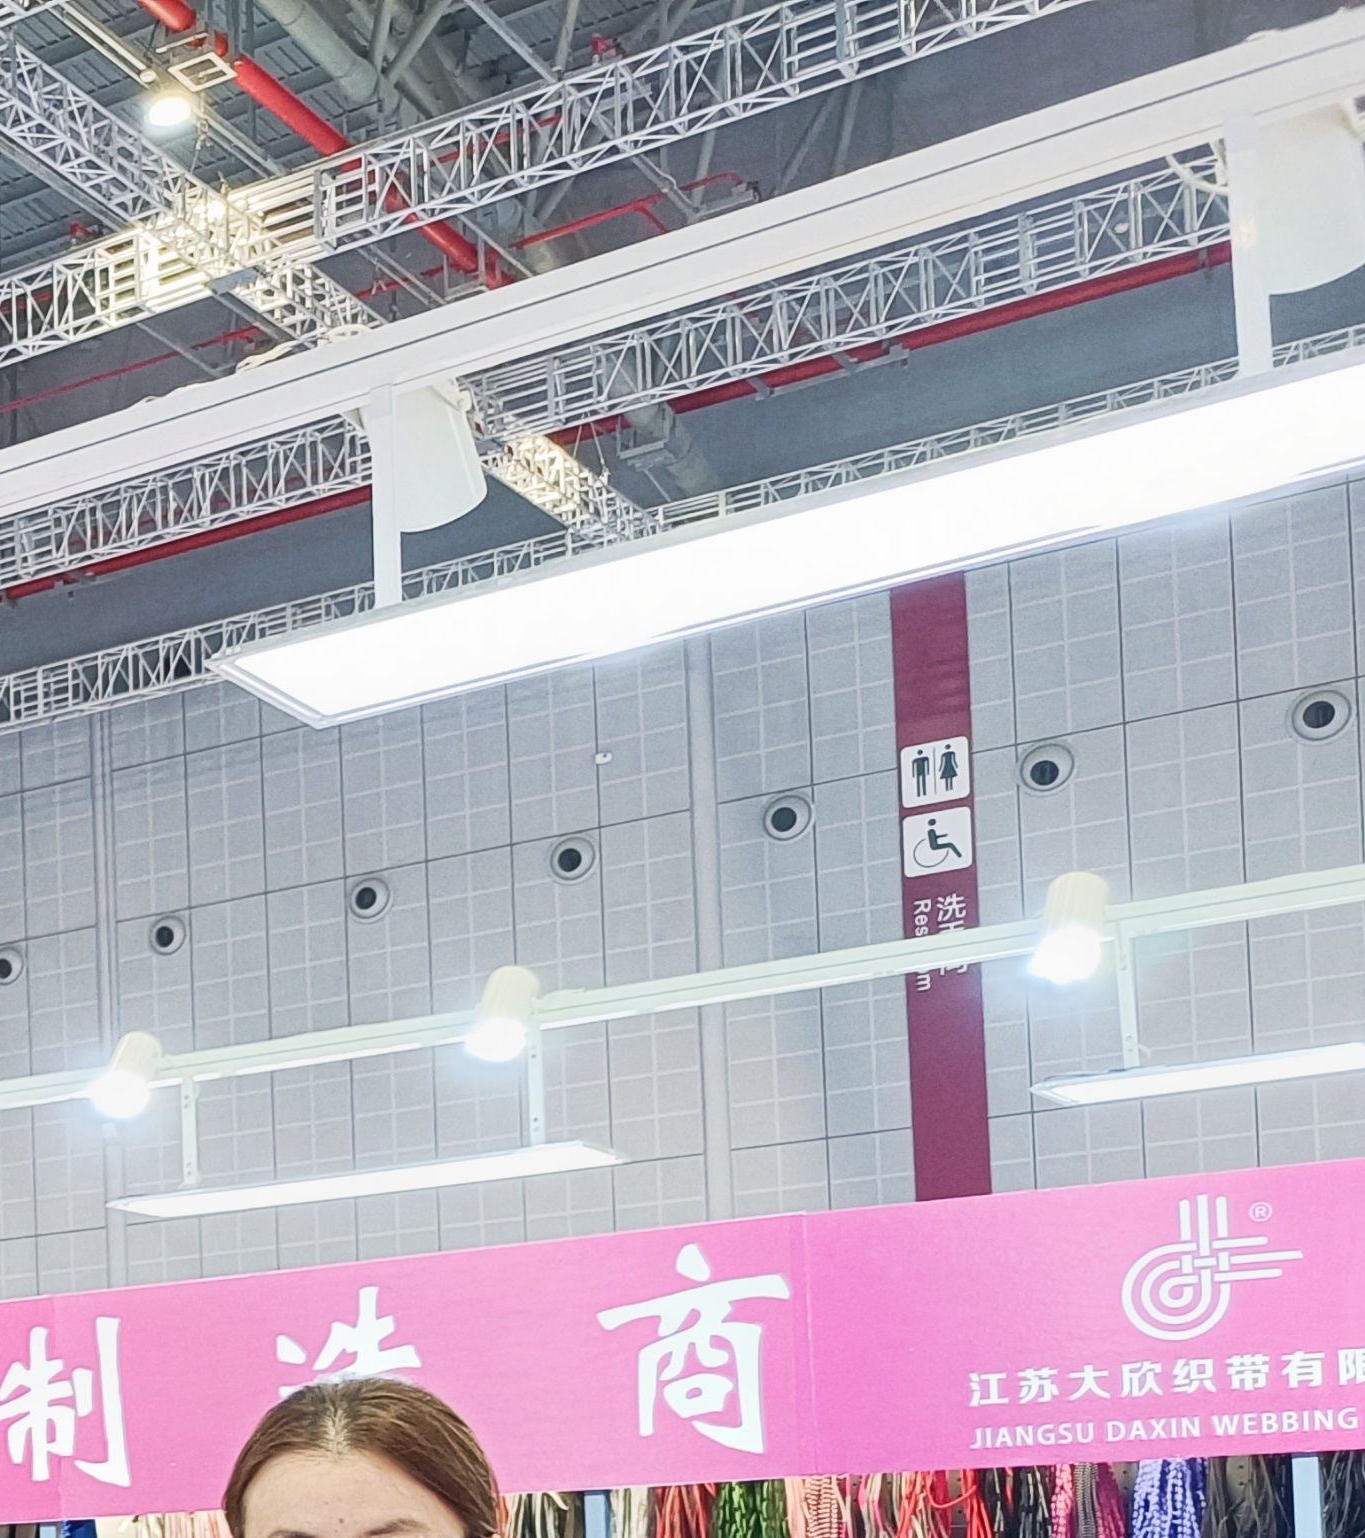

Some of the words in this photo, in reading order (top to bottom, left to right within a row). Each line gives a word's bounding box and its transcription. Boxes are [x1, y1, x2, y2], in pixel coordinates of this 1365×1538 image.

[913, 899, 932, 992] Resm
[969, 1421, 1095, 1449] JIANGSU
[1106, 1416, 1201, 1443] DAXIN
[1213, 1407, 1359, 1437] WEBBING
